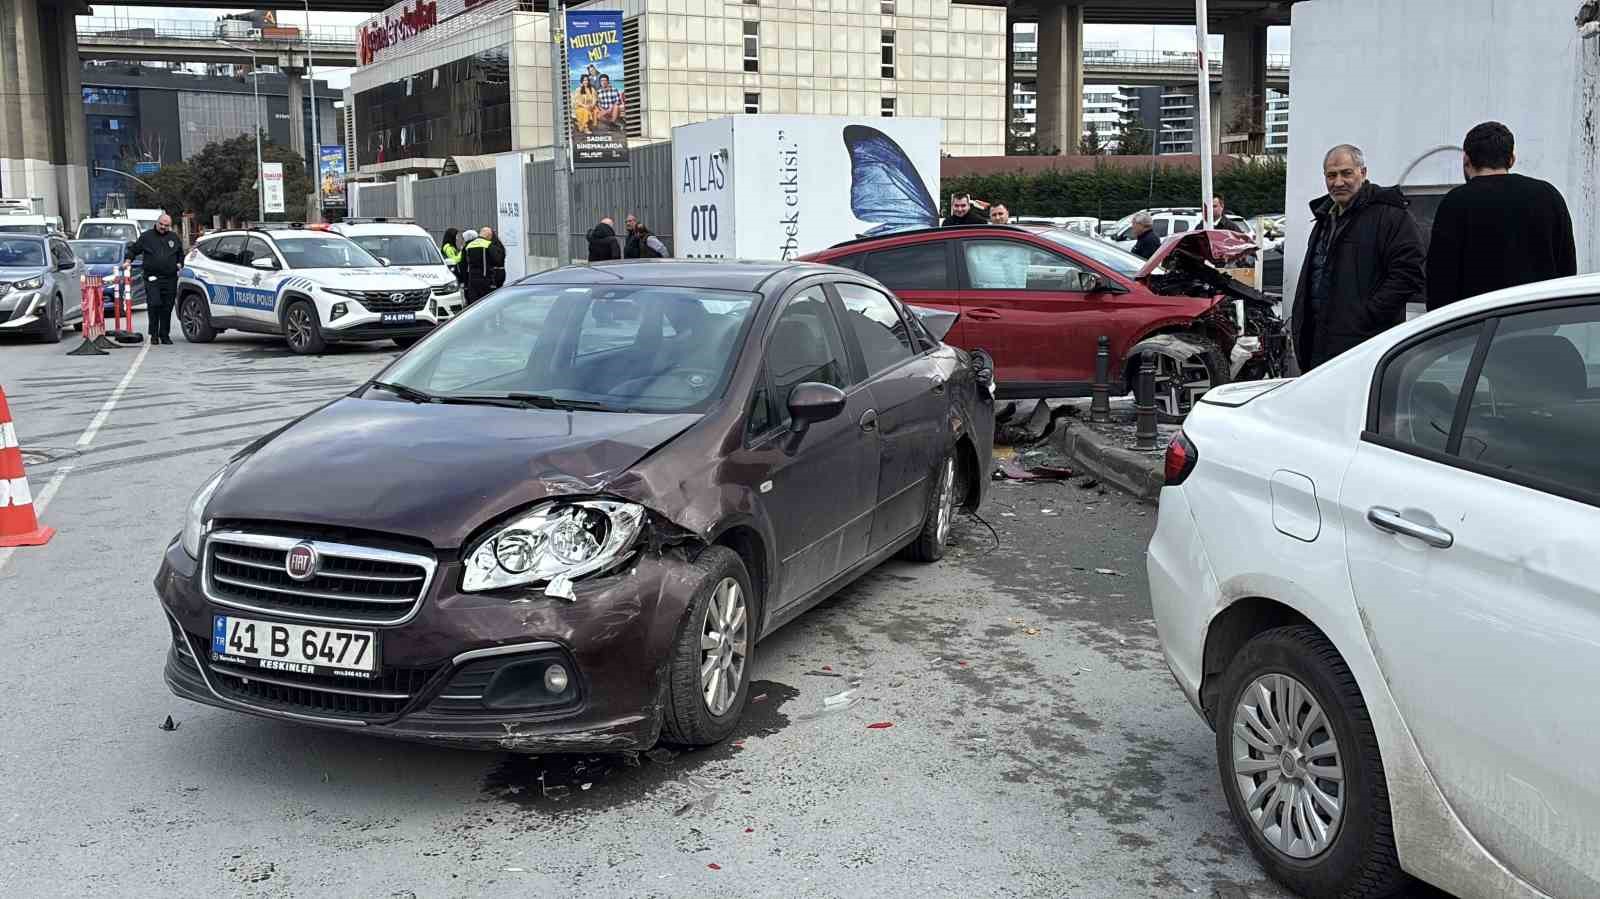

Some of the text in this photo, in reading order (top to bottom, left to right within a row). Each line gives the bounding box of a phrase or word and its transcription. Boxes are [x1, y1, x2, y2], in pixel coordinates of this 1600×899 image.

[570, 30, 619, 48] MUTLUYUZ
[683, 152, 725, 193] ATLAS
[691, 204, 718, 241] OTO
[291, 554, 310, 571] FIAT
[216, 636, 225, 646] TR
[229, 621, 371, 666] 41 B 6477
